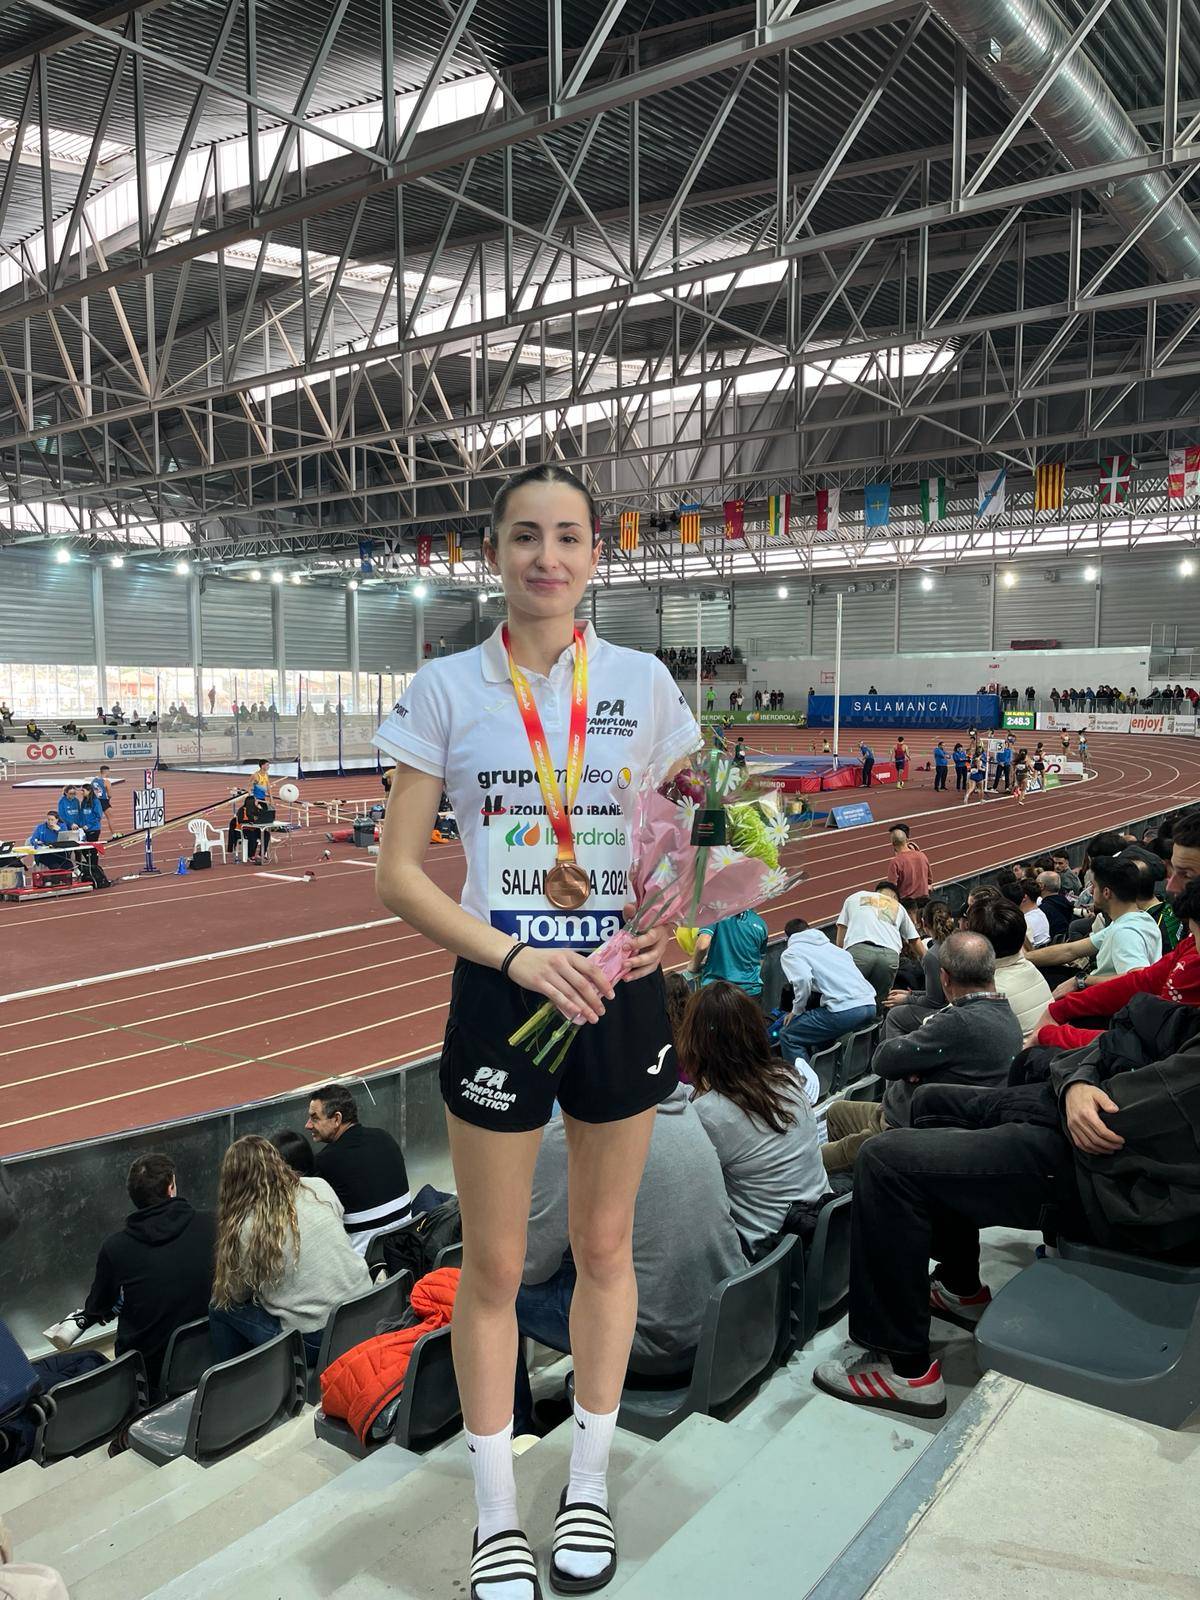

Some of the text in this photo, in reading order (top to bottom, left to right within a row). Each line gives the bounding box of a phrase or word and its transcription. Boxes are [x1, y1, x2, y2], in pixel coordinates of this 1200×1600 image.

[596, 699, 625, 716] PA
[853, 701, 948, 711] SALAMANCA
[587, 727, 633, 737] ATLETICO
[1131, 715, 1164, 732] enjoy!
[601, 870, 628, 895] 2024
[473, 1066, 509, 1090] PA
[460, 1078, 517, 1103] PAMPLONA
[461, 1089, 510, 1111] ATLETICO
